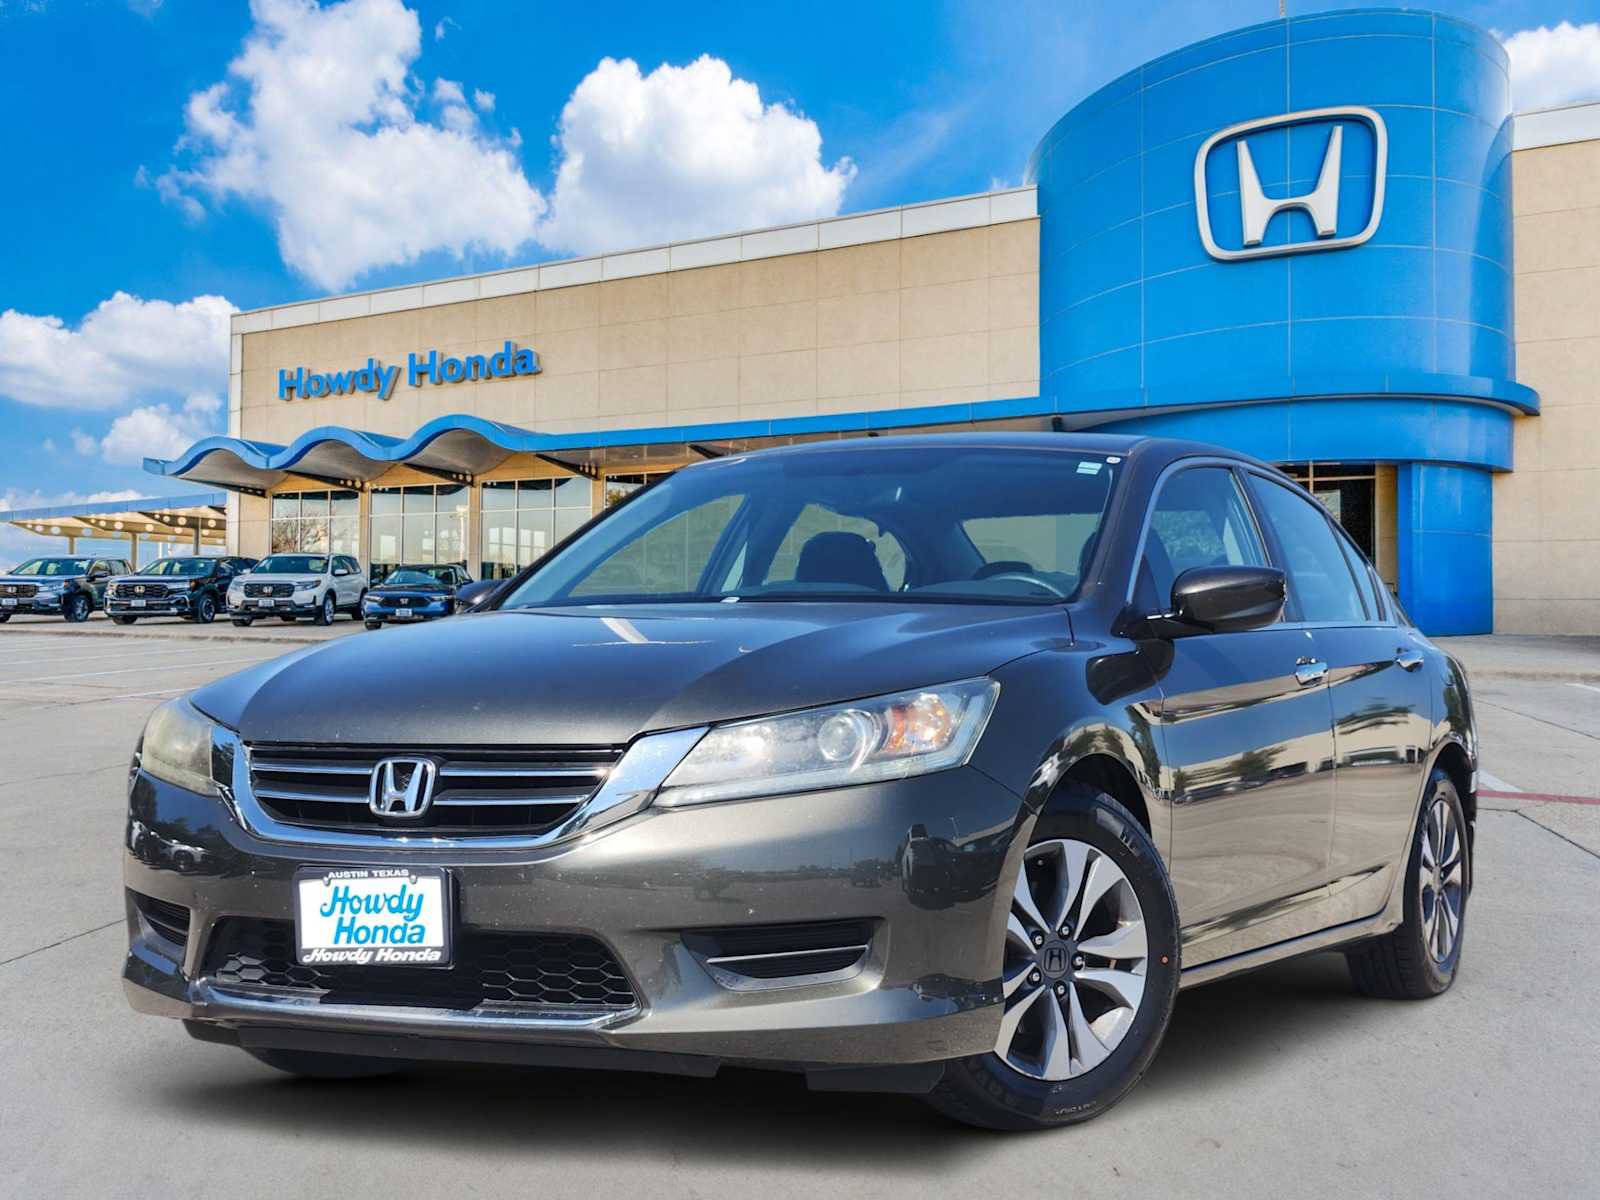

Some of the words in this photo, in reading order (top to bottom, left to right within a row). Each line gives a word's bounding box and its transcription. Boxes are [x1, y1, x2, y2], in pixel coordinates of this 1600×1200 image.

[278, 358, 401, 402] Howdy
[407, 341, 542, 387] Honda
[328, 870, 368, 879] AUSTIN
[372, 869, 409, 878] TEXAS
[320, 884, 424, 922] Howdy
[333, 916, 426, 945] Honda
[302, 948, 374, 964] Howdy
[375, 947, 442, 962] Honda
